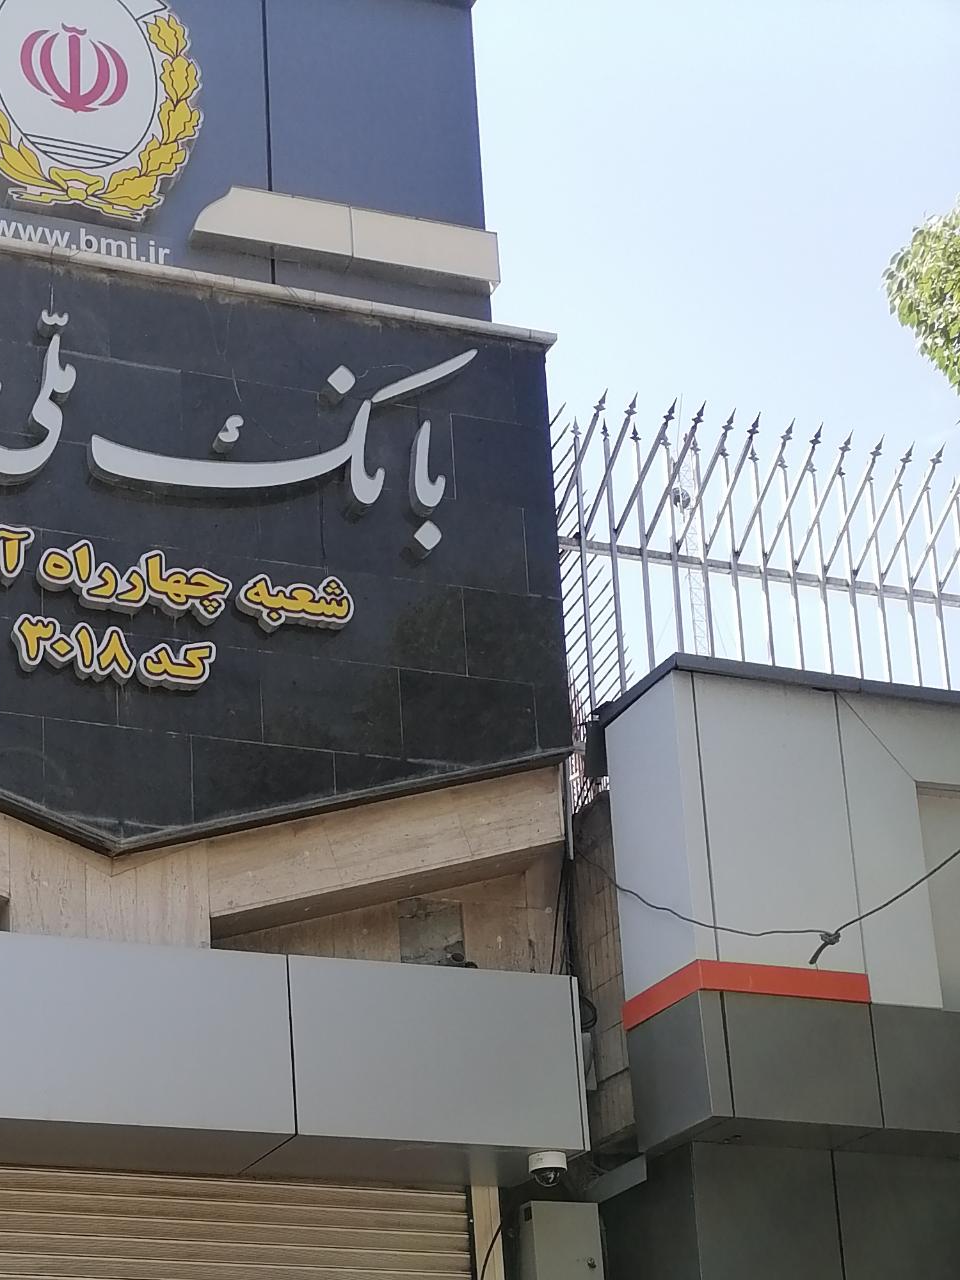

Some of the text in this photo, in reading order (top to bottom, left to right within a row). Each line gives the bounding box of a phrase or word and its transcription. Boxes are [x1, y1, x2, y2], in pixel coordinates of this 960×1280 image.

[90, 348, 479, 552] بانک
[40, 539, 233, 616] چهارراه
[240, 574, 356, 626] شعبه
[14, 614, 217, 684] کد ۳۰۱۸
